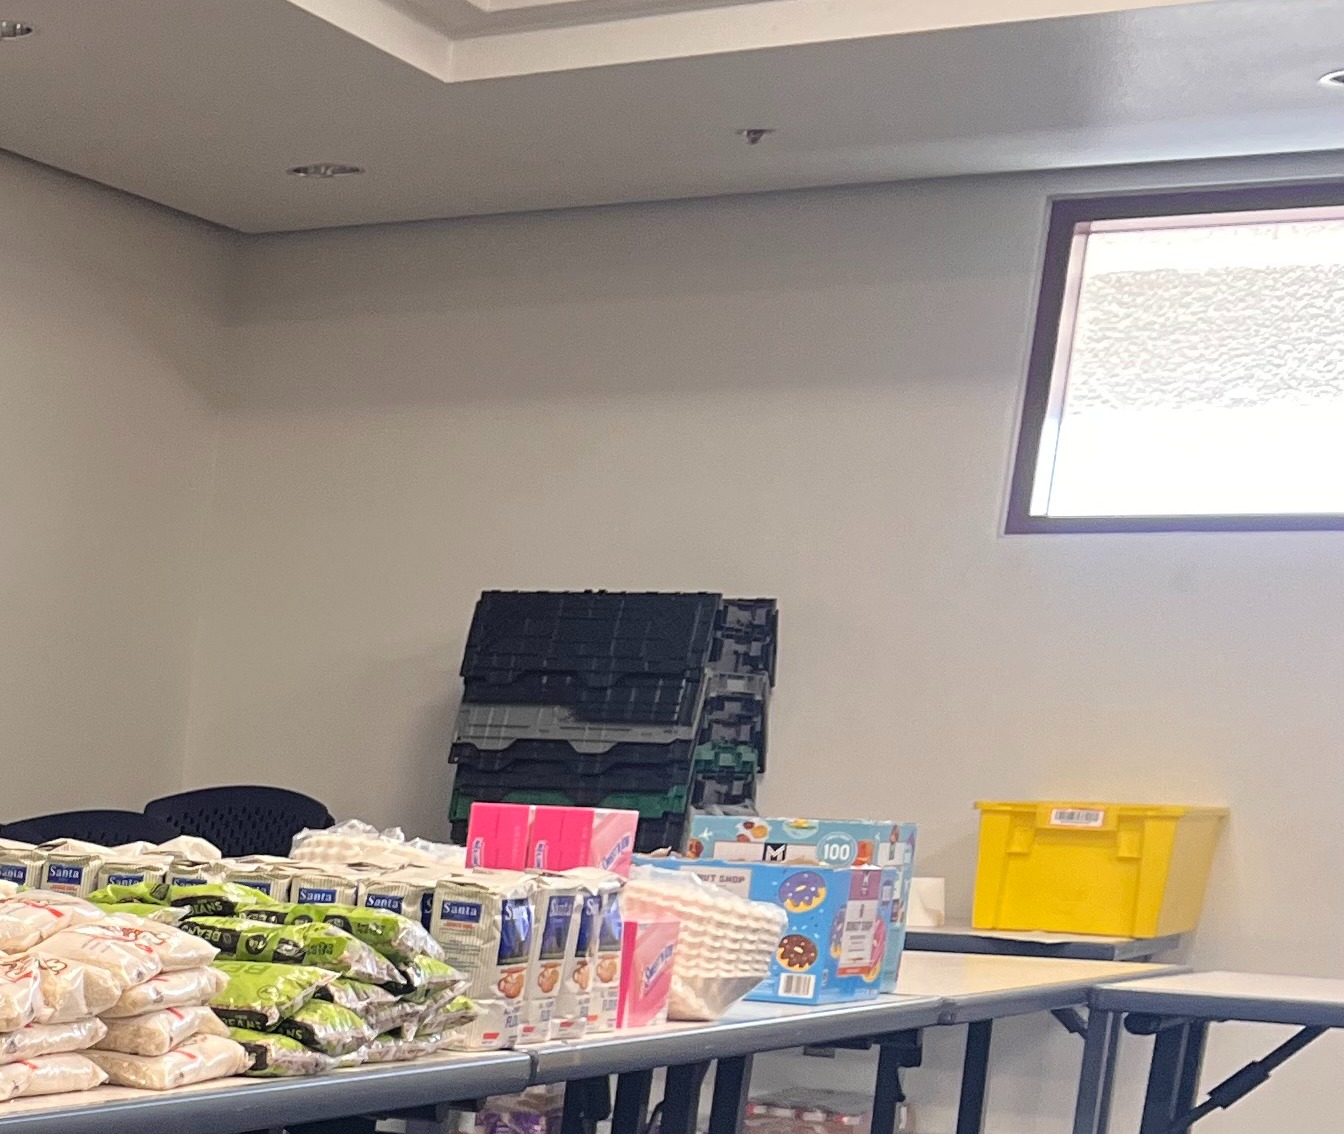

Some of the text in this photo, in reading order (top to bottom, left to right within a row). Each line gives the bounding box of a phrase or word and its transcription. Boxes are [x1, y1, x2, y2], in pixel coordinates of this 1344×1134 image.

[823, 843, 850, 861] 100
[49, 866, 80, 879] Santa
[300, 889, 332, 903] Santa
[443, 902, 479, 917] Santa
